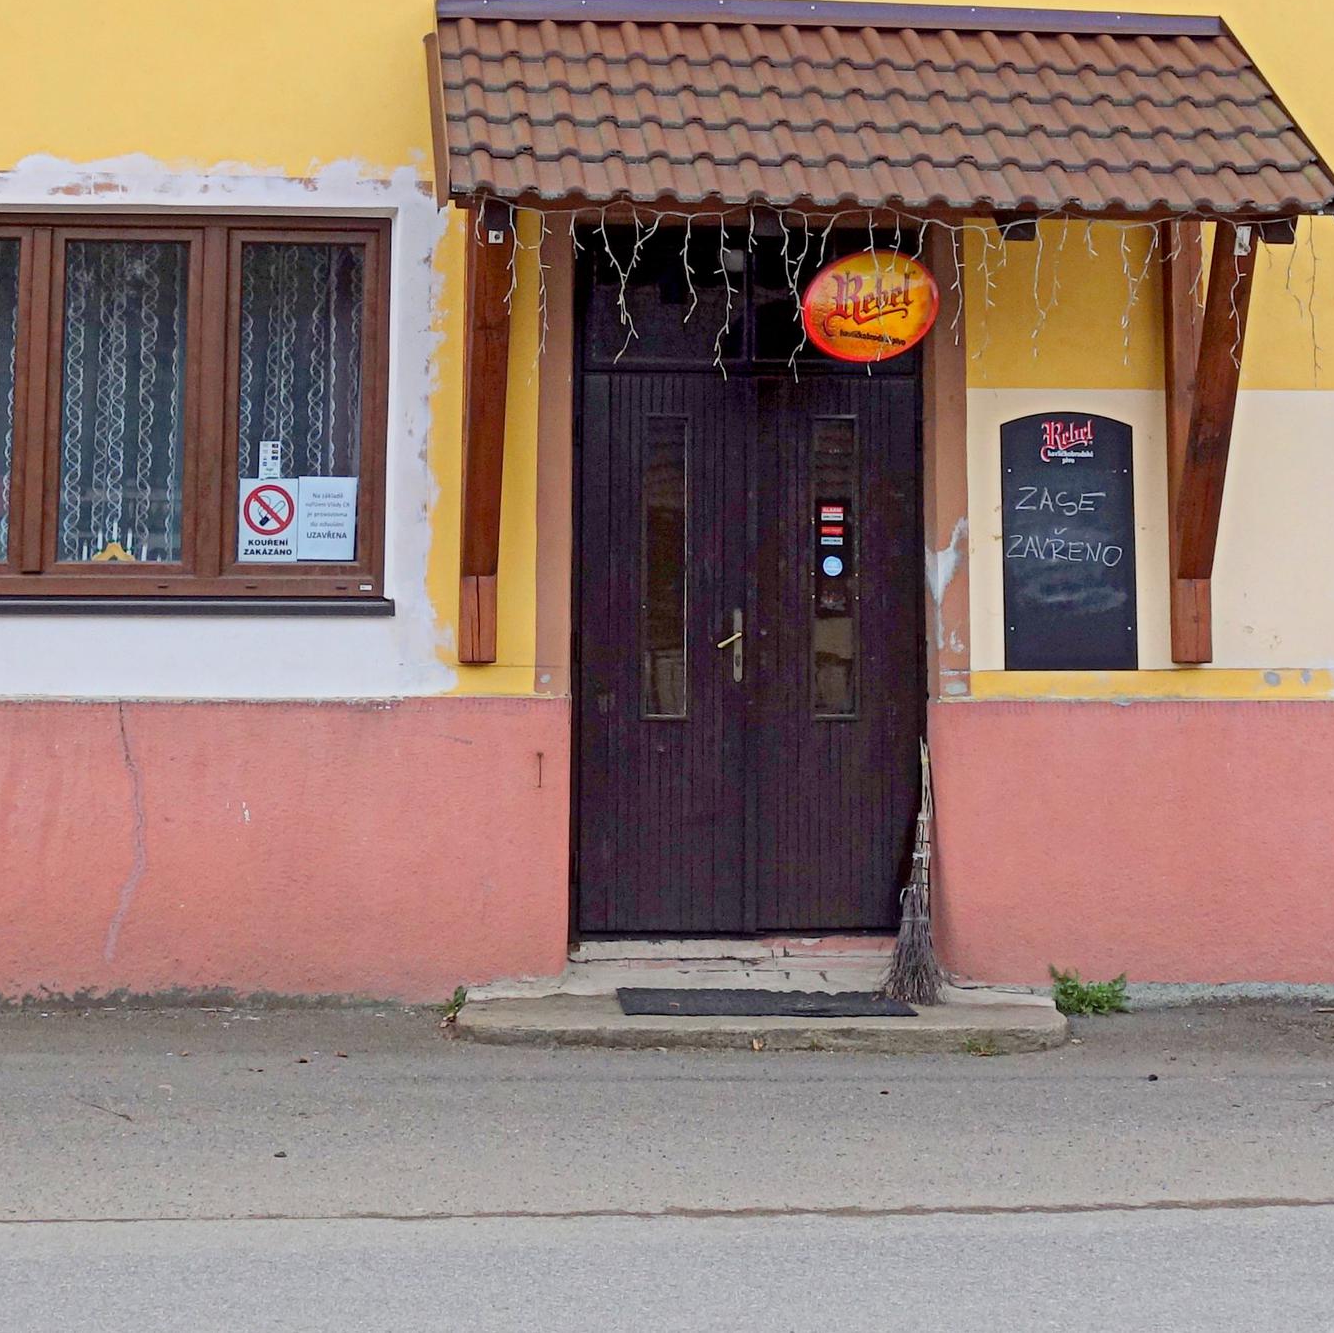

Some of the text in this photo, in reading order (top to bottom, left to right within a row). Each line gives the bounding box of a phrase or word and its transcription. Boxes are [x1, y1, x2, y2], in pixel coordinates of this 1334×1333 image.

[824, 270, 915, 325] Rebel
[1041, 419, 1094, 452] Rebel
[1015, 486, 1106, 516] ZASE
[248, 538, 289, 546] KOUŘENÍ
[306, 530, 348, 539] UZAVŘENA
[1006, 527, 1123, 567] ZAVŘENO
[243, 547, 293, 556] ZAKÁZÁNO
